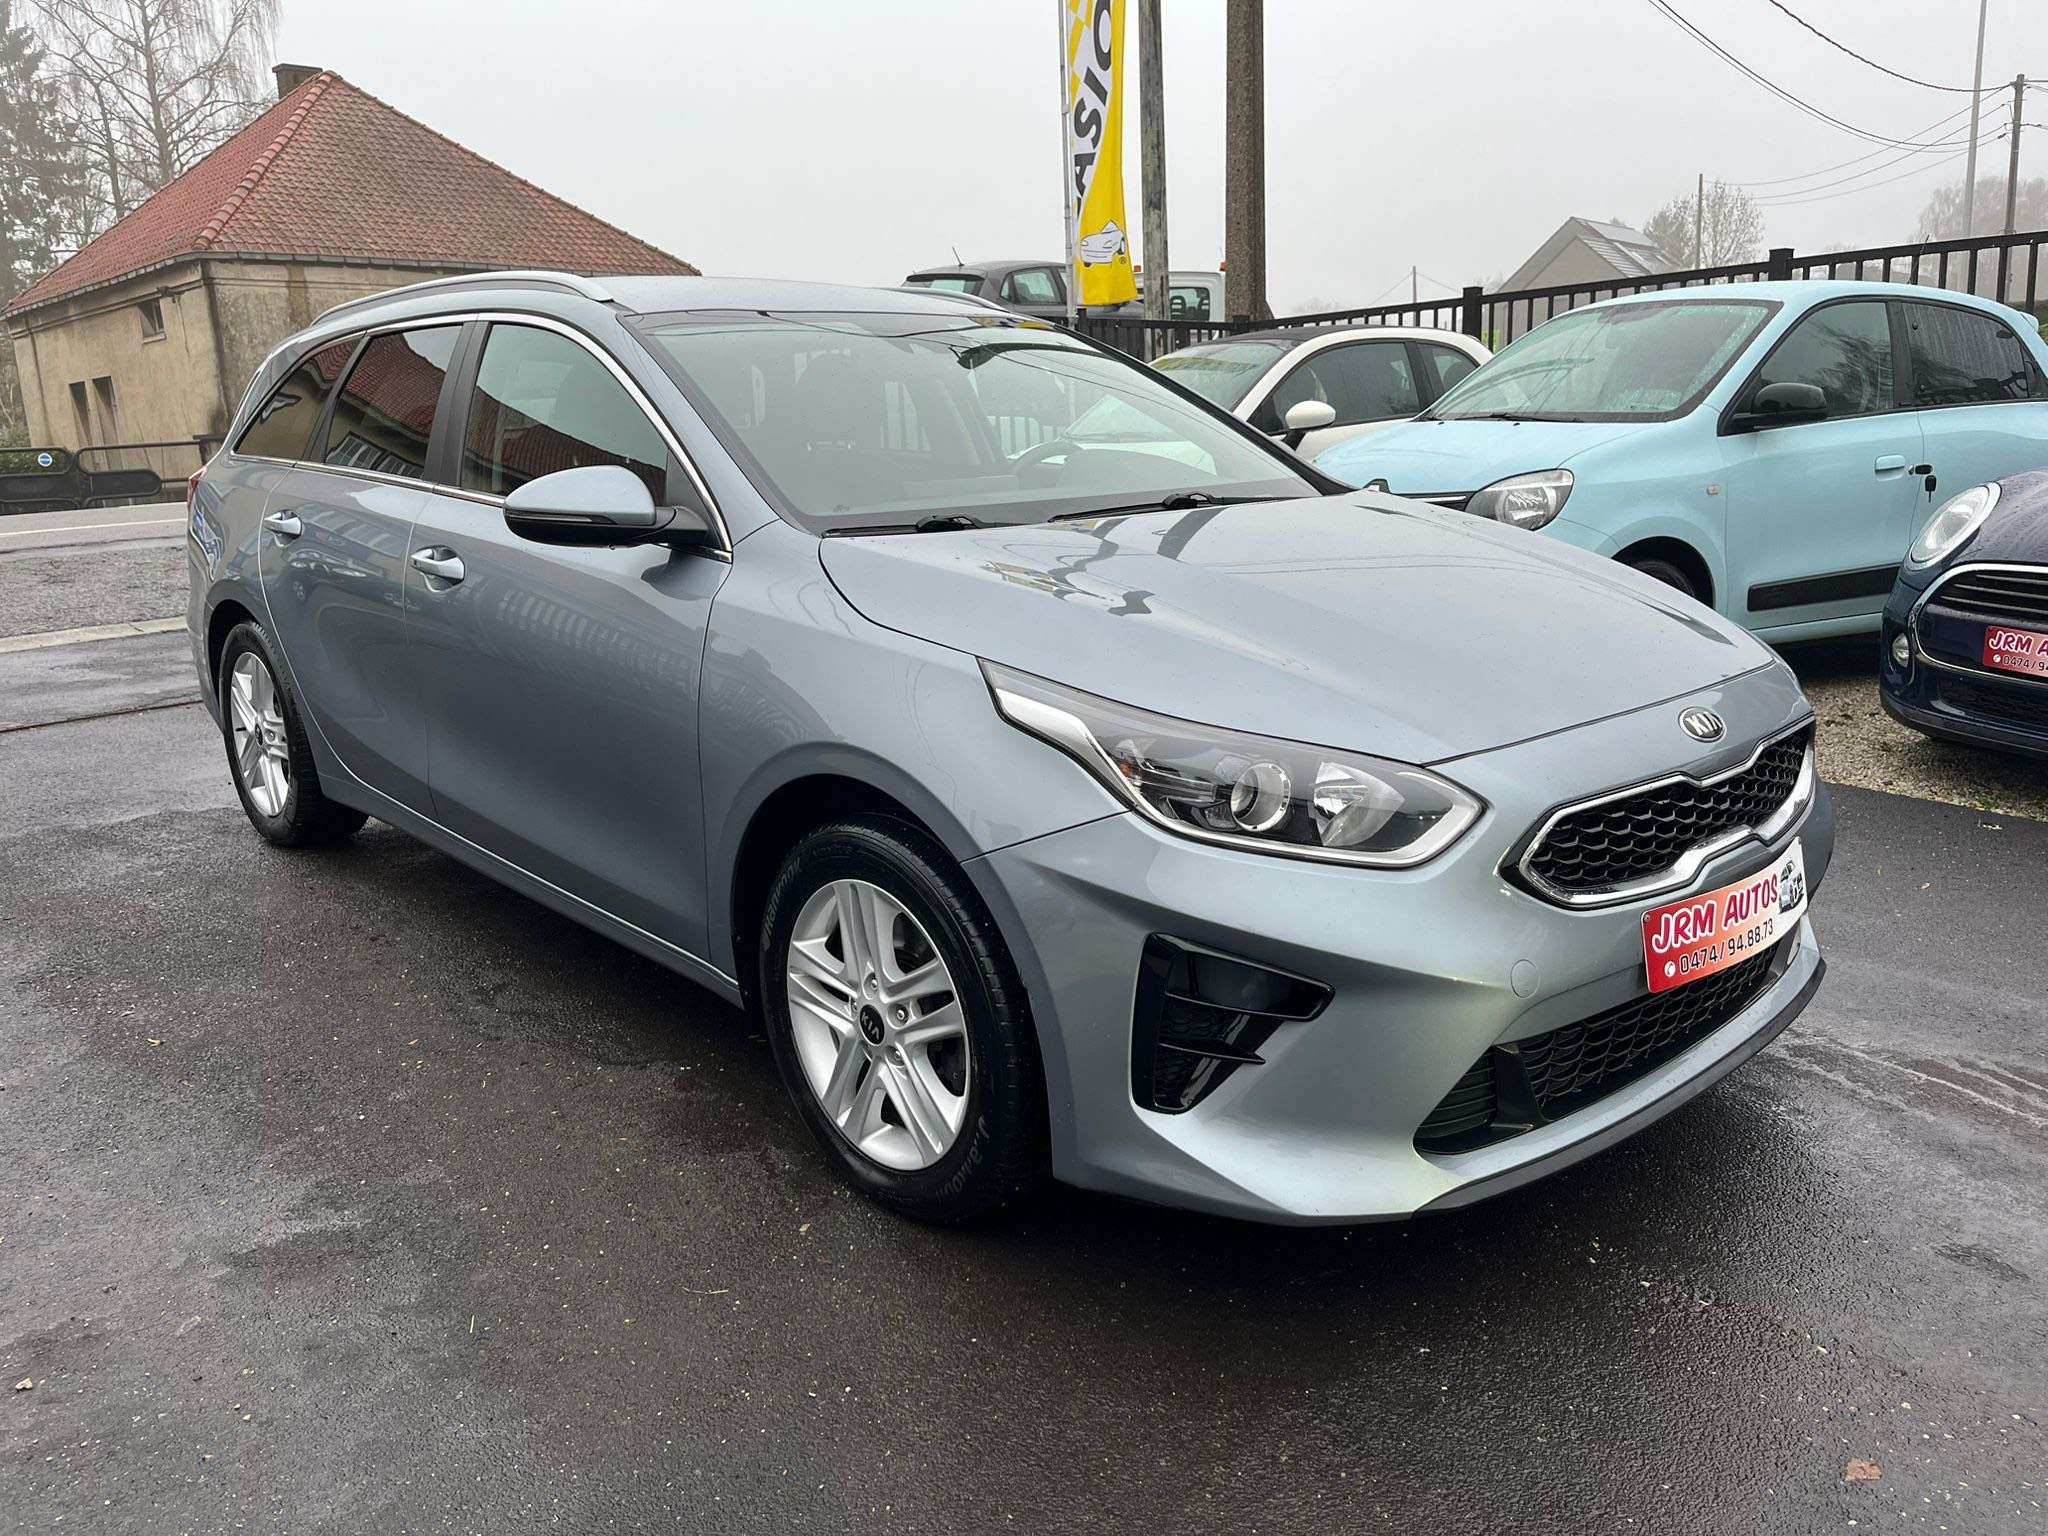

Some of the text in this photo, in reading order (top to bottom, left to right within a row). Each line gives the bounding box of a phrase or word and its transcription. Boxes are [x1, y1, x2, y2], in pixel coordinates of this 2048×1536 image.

[1073, 0, 1112, 219] ASIO
[1989, 631, 2034, 655] JRM
[1684, 711, 1722, 736] KIA
[1653, 873, 1778, 952] JRM AUTOS
[861, 1011, 880, 1040] KIA
